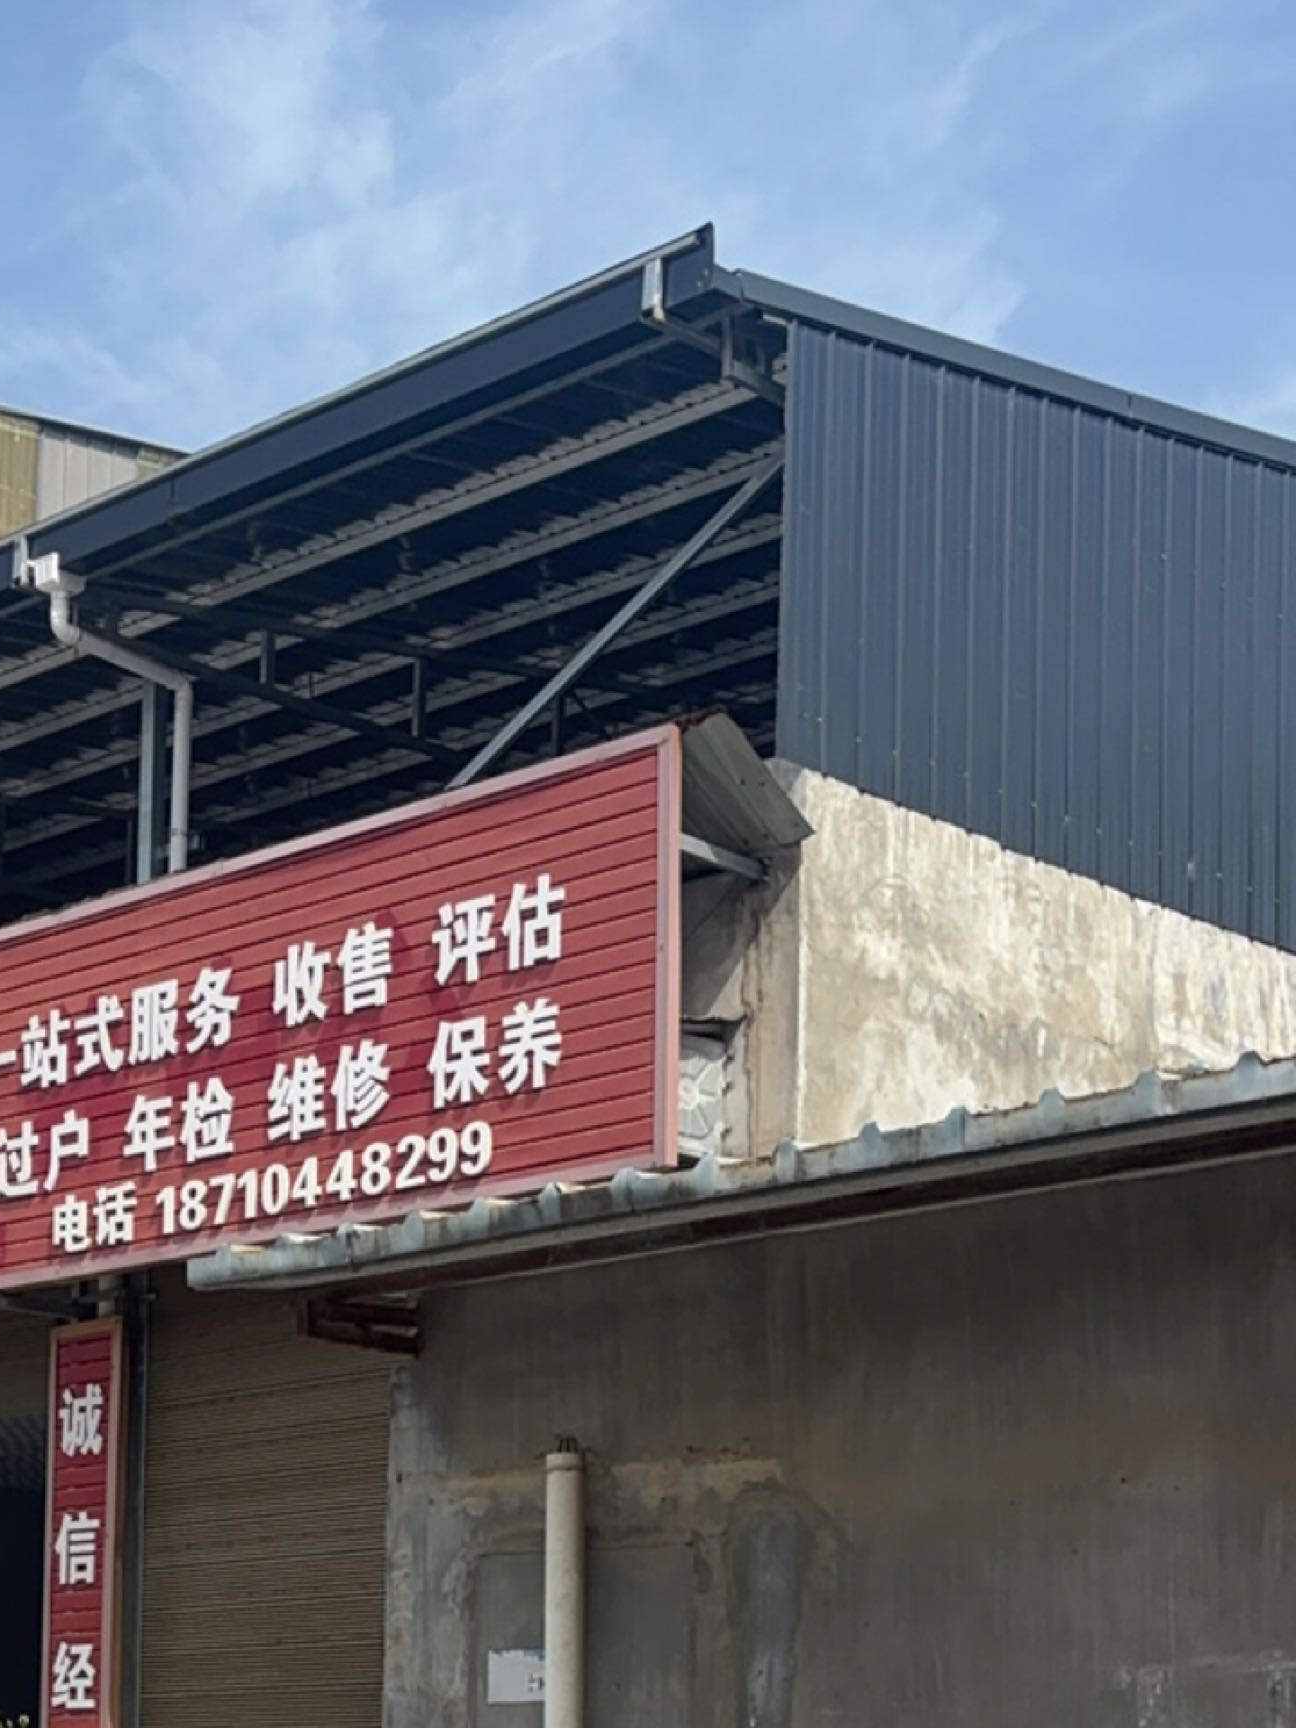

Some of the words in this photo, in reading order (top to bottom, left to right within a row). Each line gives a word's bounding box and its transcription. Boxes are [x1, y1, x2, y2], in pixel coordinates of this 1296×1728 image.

[273, 921, 394, 1028] 收售
[432, 873, 566, 985] 评估
[122, 1076, 235, 1173] 年检
[267, 1038, 391, 1143] 维修
[428, 997, 563, 1109] 保养
[52, 1180, 138, 1254] 电话
[155, 1120, 494, 1235] 18710448299
